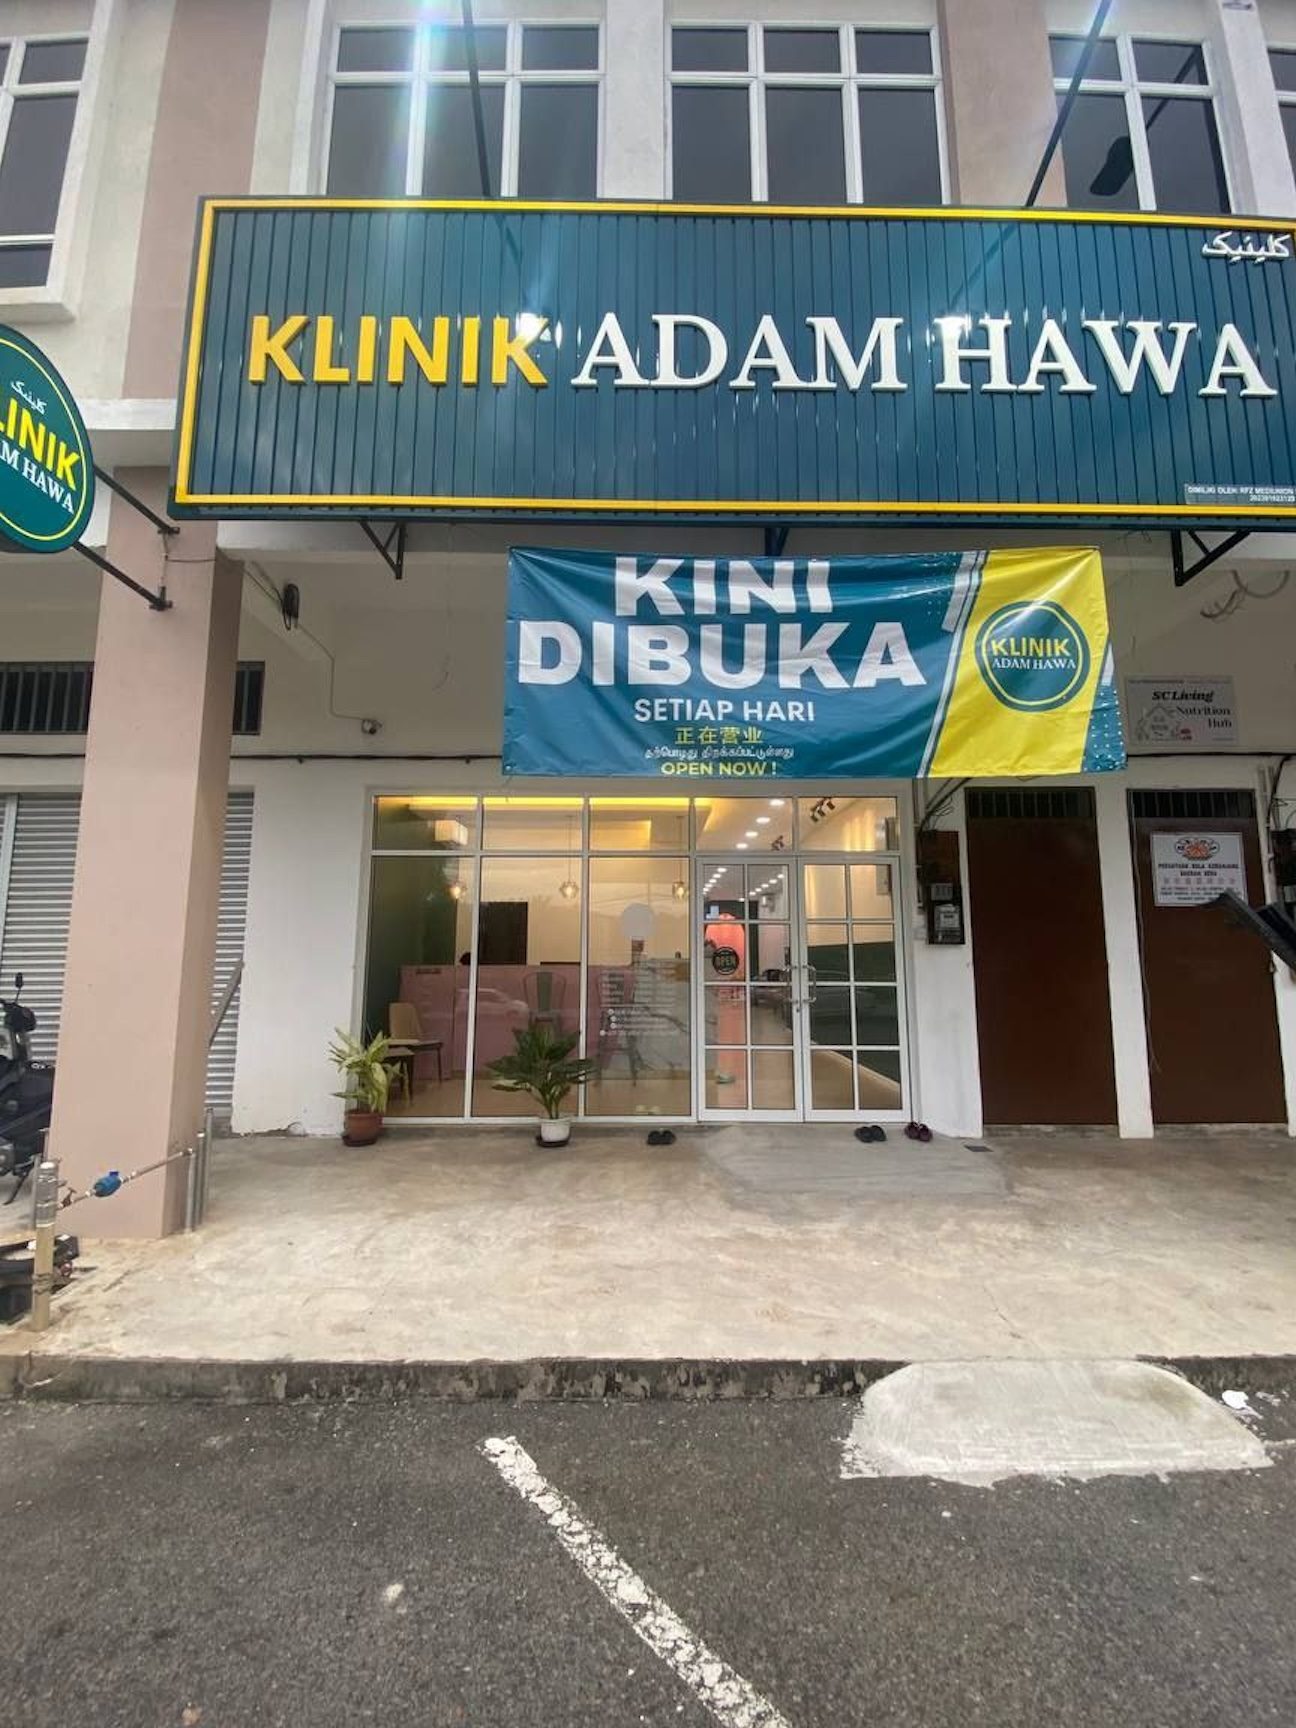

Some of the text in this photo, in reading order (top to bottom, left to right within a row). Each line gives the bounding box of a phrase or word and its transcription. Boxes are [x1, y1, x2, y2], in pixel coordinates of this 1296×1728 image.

[248, 312, 1278, 398] KLINIK ADAM HAWA
[22, 456, 75, 515] HAWA
[614, 556, 834, 617] KINI
[518, 620, 928, 690] DIBUKA
[990, 637, 1072, 658] KLINIK
[991, 658, 1076, 670] ADAM HAWA
[633, 698, 816, 723] SETIAP HARI
[1175, 705, 1232, 716] Nutrition
[1207, 717, 1233, 729] Hub
[675, 725, 764, 745] 正在营业
[660, 761, 713, 777] OPEN
[718, 761, 767, 777] NOW
